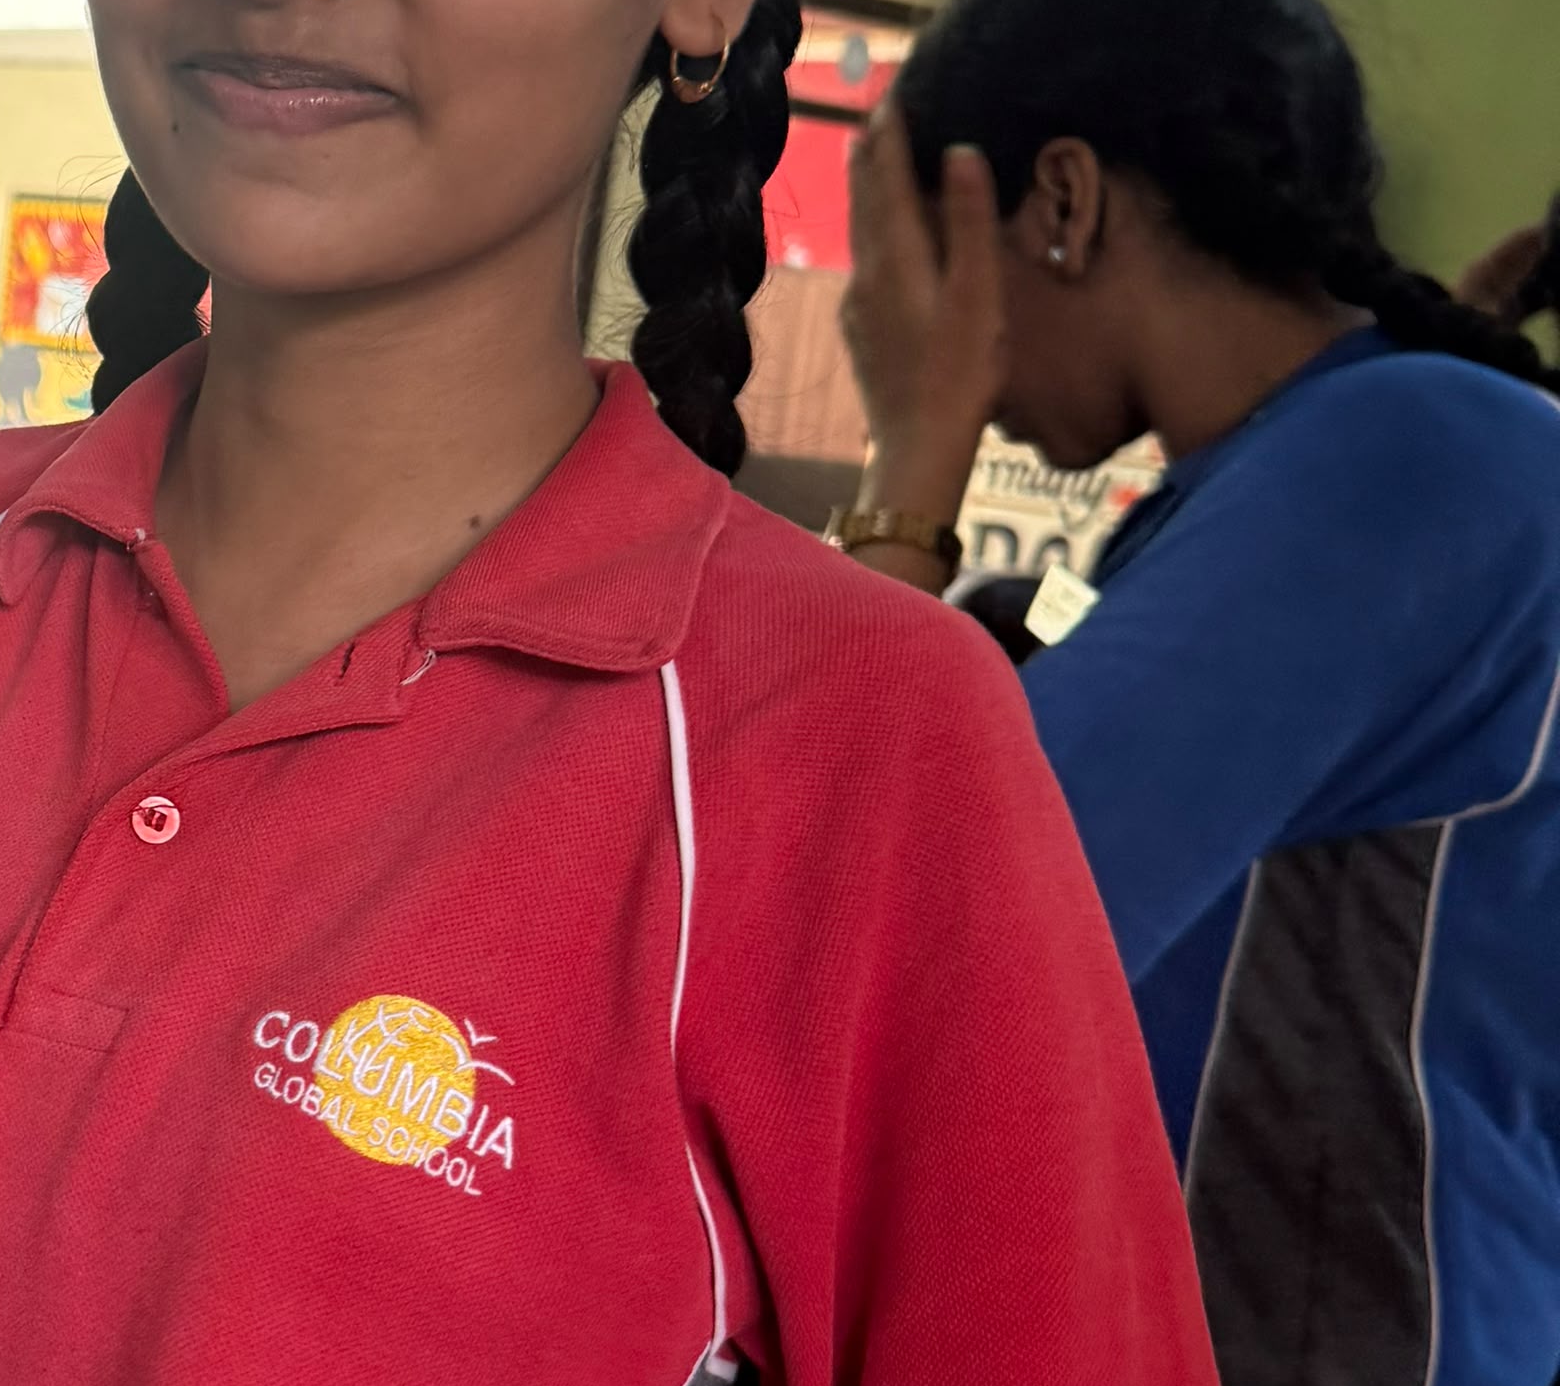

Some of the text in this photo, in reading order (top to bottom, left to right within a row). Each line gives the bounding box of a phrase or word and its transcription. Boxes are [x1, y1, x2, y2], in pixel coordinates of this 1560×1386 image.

[253, 1009, 515, 1170] COLUMBIA
[253, 1062, 483, 1196] GLOBAL SCHOOL
